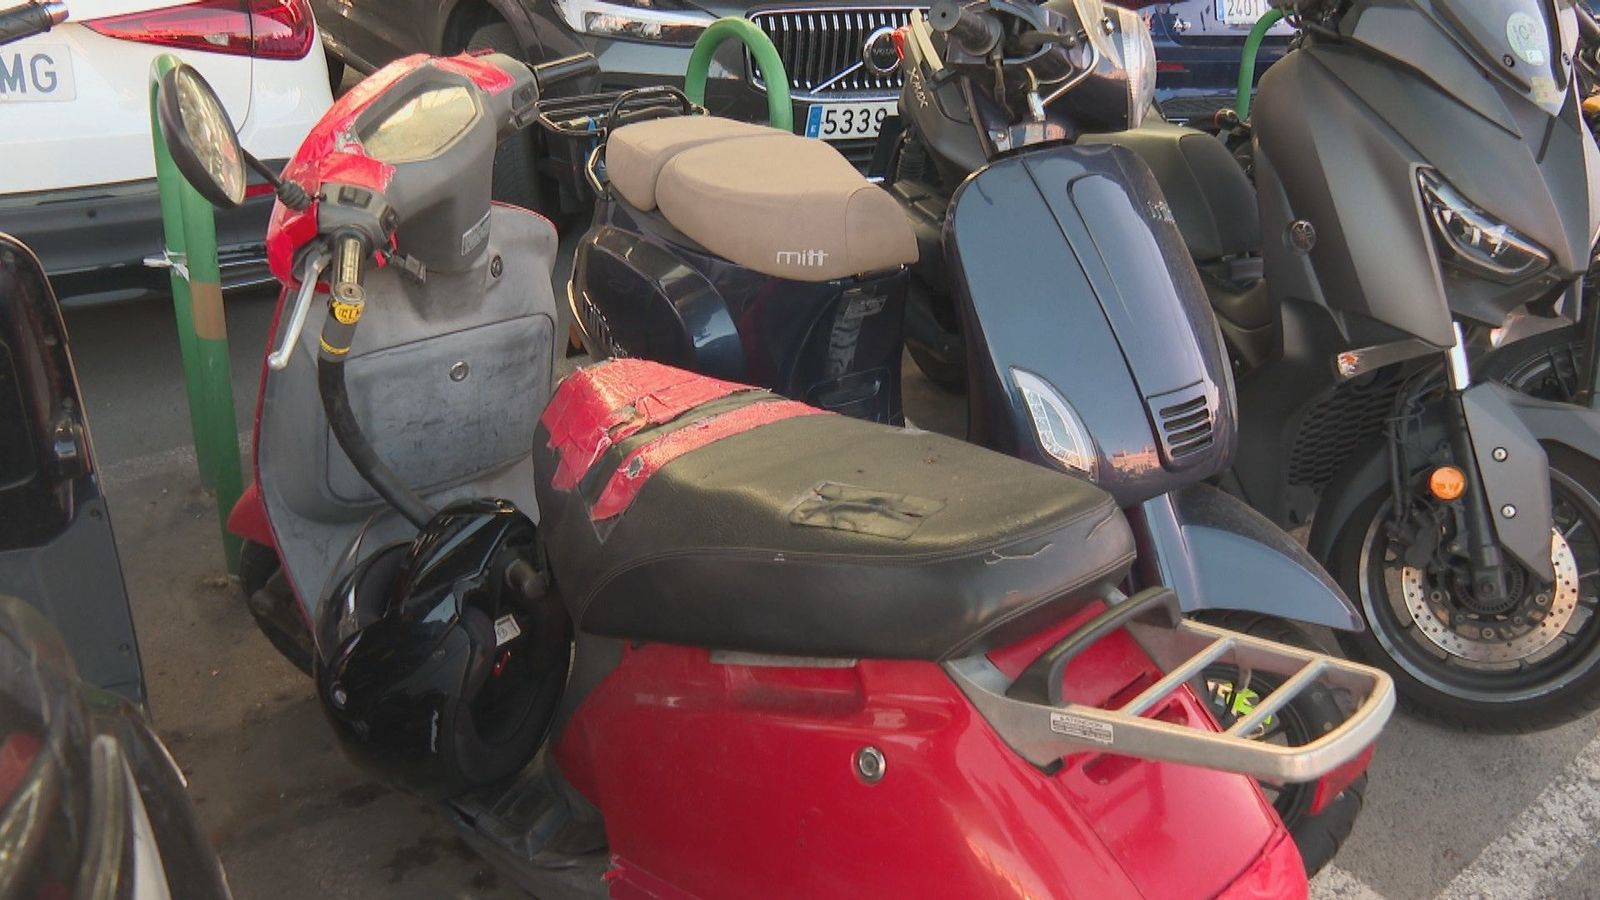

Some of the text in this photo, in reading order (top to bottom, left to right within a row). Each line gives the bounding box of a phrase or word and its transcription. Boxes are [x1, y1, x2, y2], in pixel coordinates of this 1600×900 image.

[0, 53, 58, 94] MG
[823, 107, 888, 135] 5339
[776, 249, 829, 266] mitt
